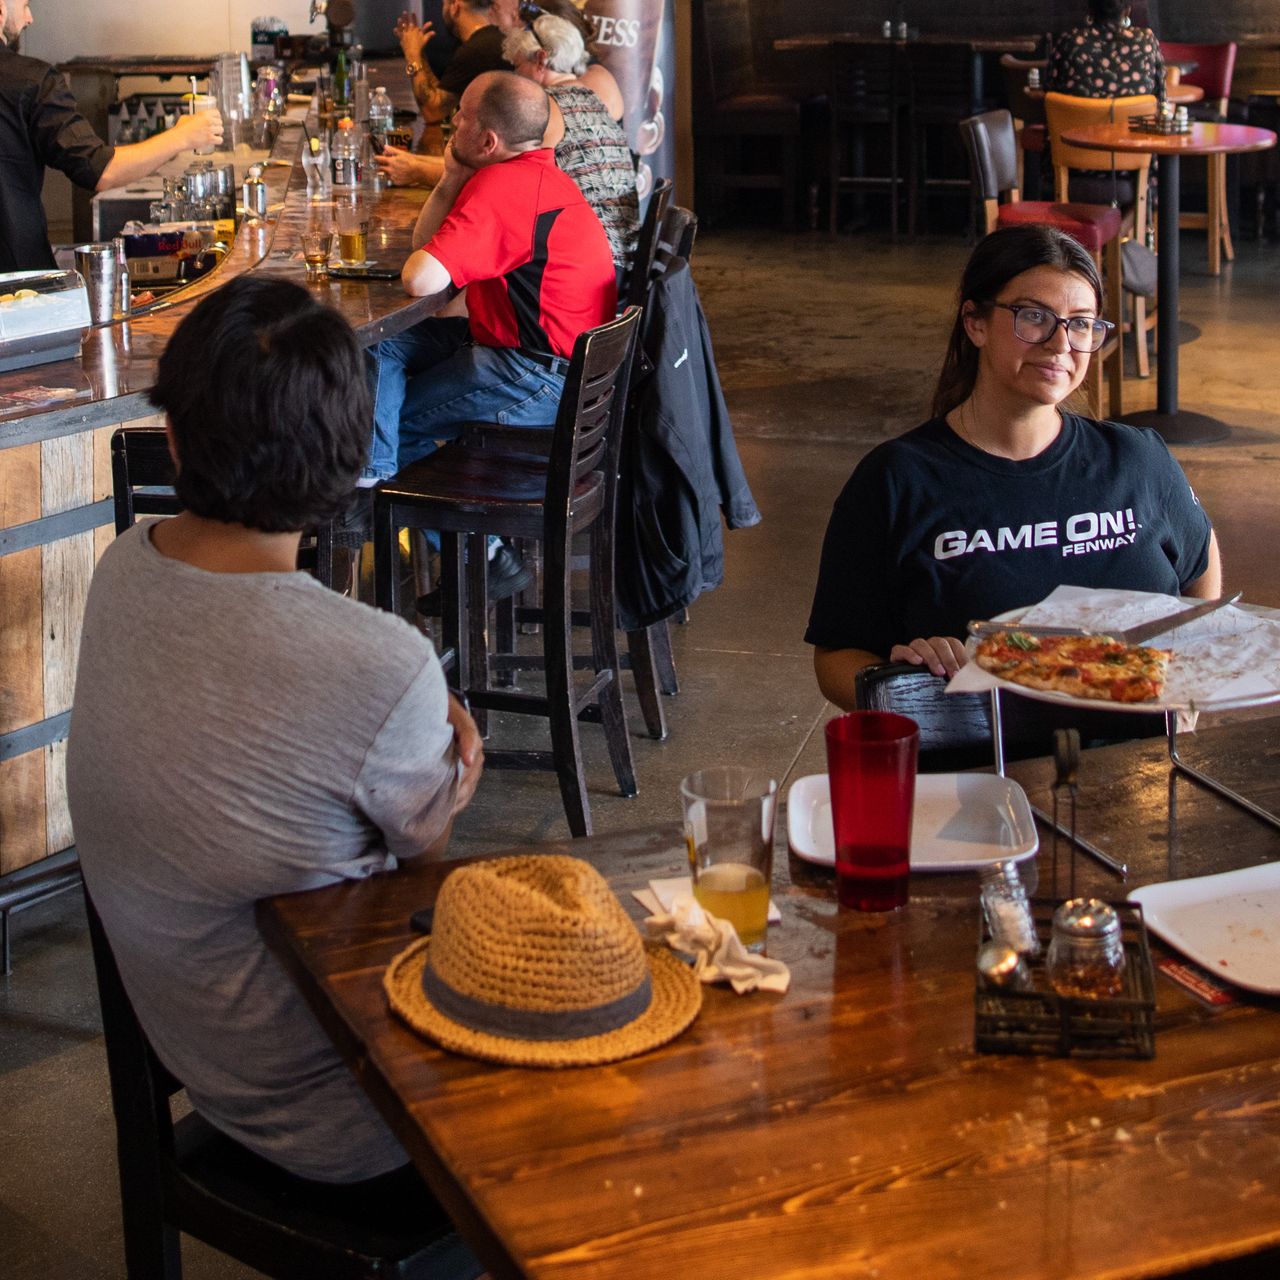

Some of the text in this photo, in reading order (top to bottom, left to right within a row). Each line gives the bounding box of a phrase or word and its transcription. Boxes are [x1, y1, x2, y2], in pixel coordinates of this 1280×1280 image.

[933, 507, 1137, 561] GAME ON!
[1062, 532, 1137, 558] FENWAY
